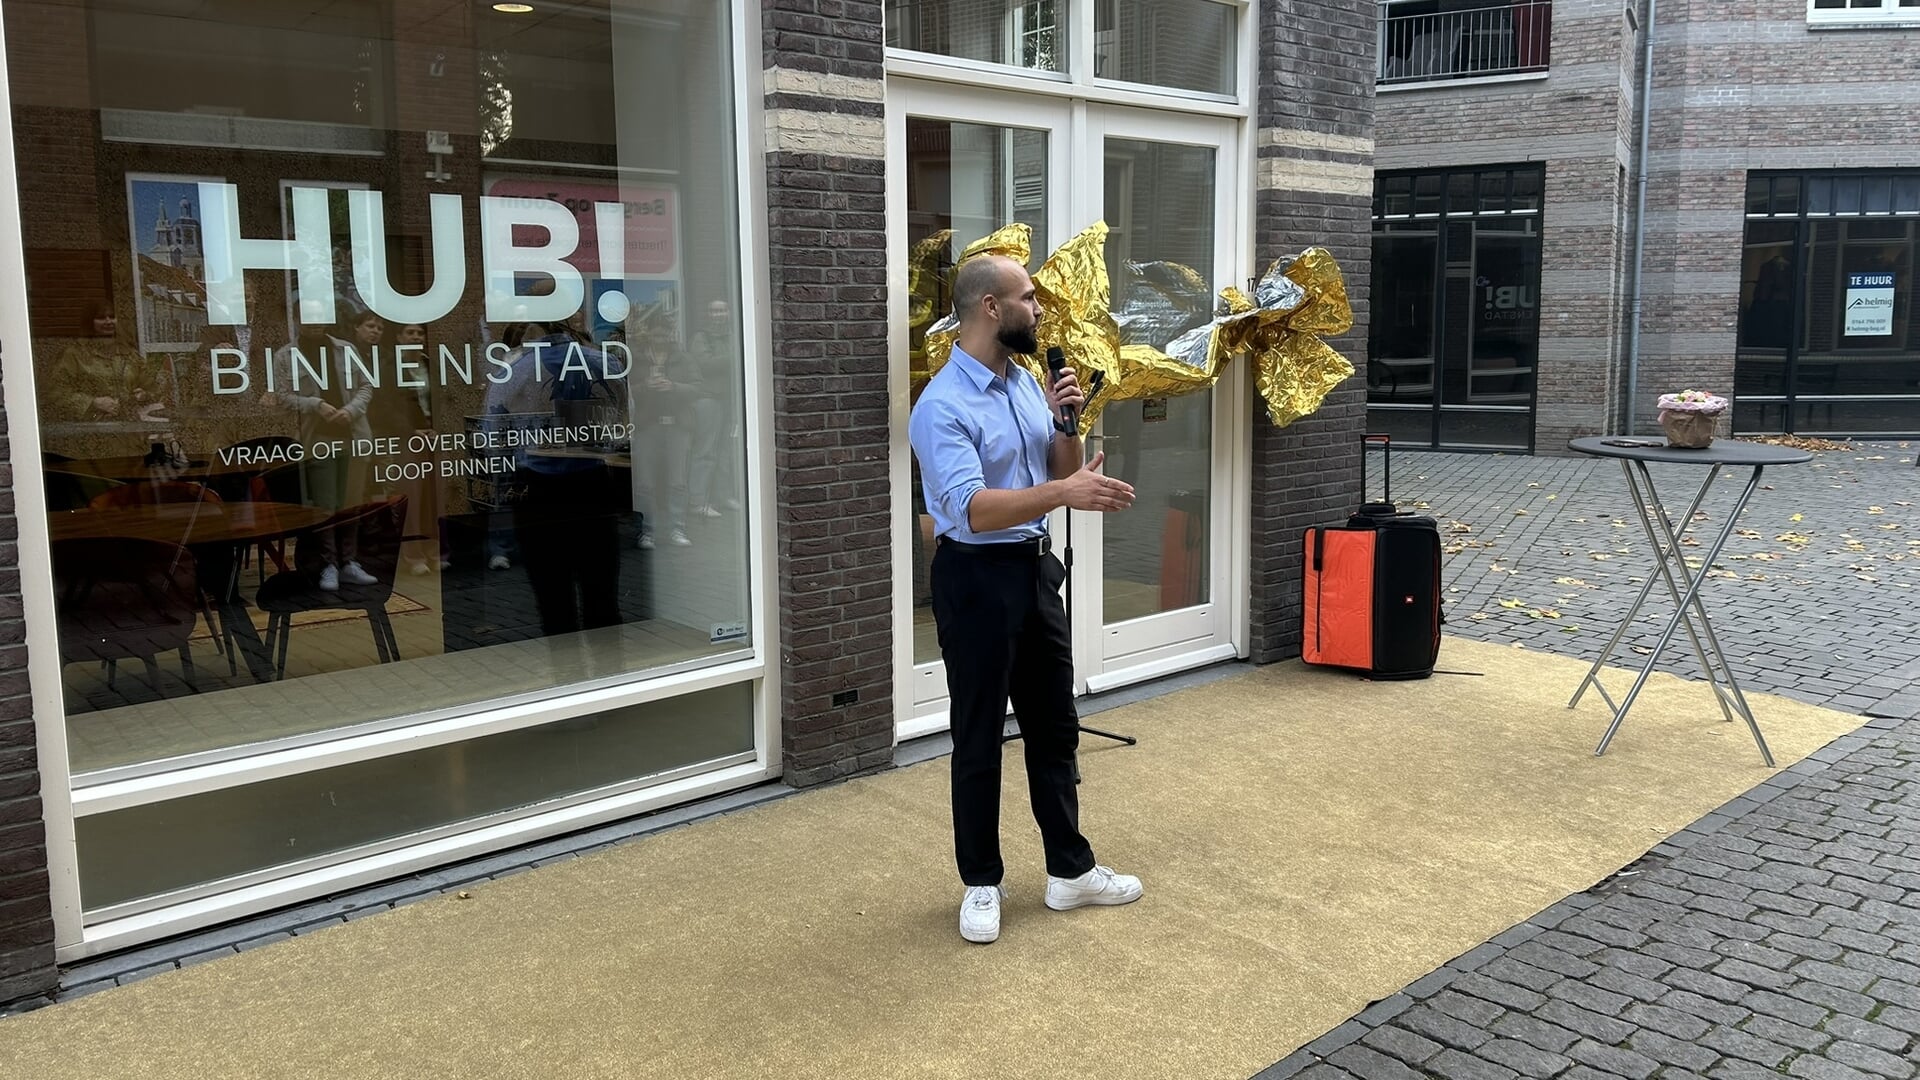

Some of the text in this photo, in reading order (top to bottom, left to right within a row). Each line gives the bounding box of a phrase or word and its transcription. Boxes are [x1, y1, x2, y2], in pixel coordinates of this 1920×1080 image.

[197, 182, 630, 325] HUB!
[1247, 277, 1257, 292] 17
[1850, 275, 1893, 286] TE HUUR
[1864, 297, 1893, 308] helmig
[210, 341, 633, 395] BINNENSTAD
[218, 423, 636, 466] VRAAG OF IDEE OVER DE BINNENSTAD?
[375, 456, 516, 482] LOOP BINNEN
